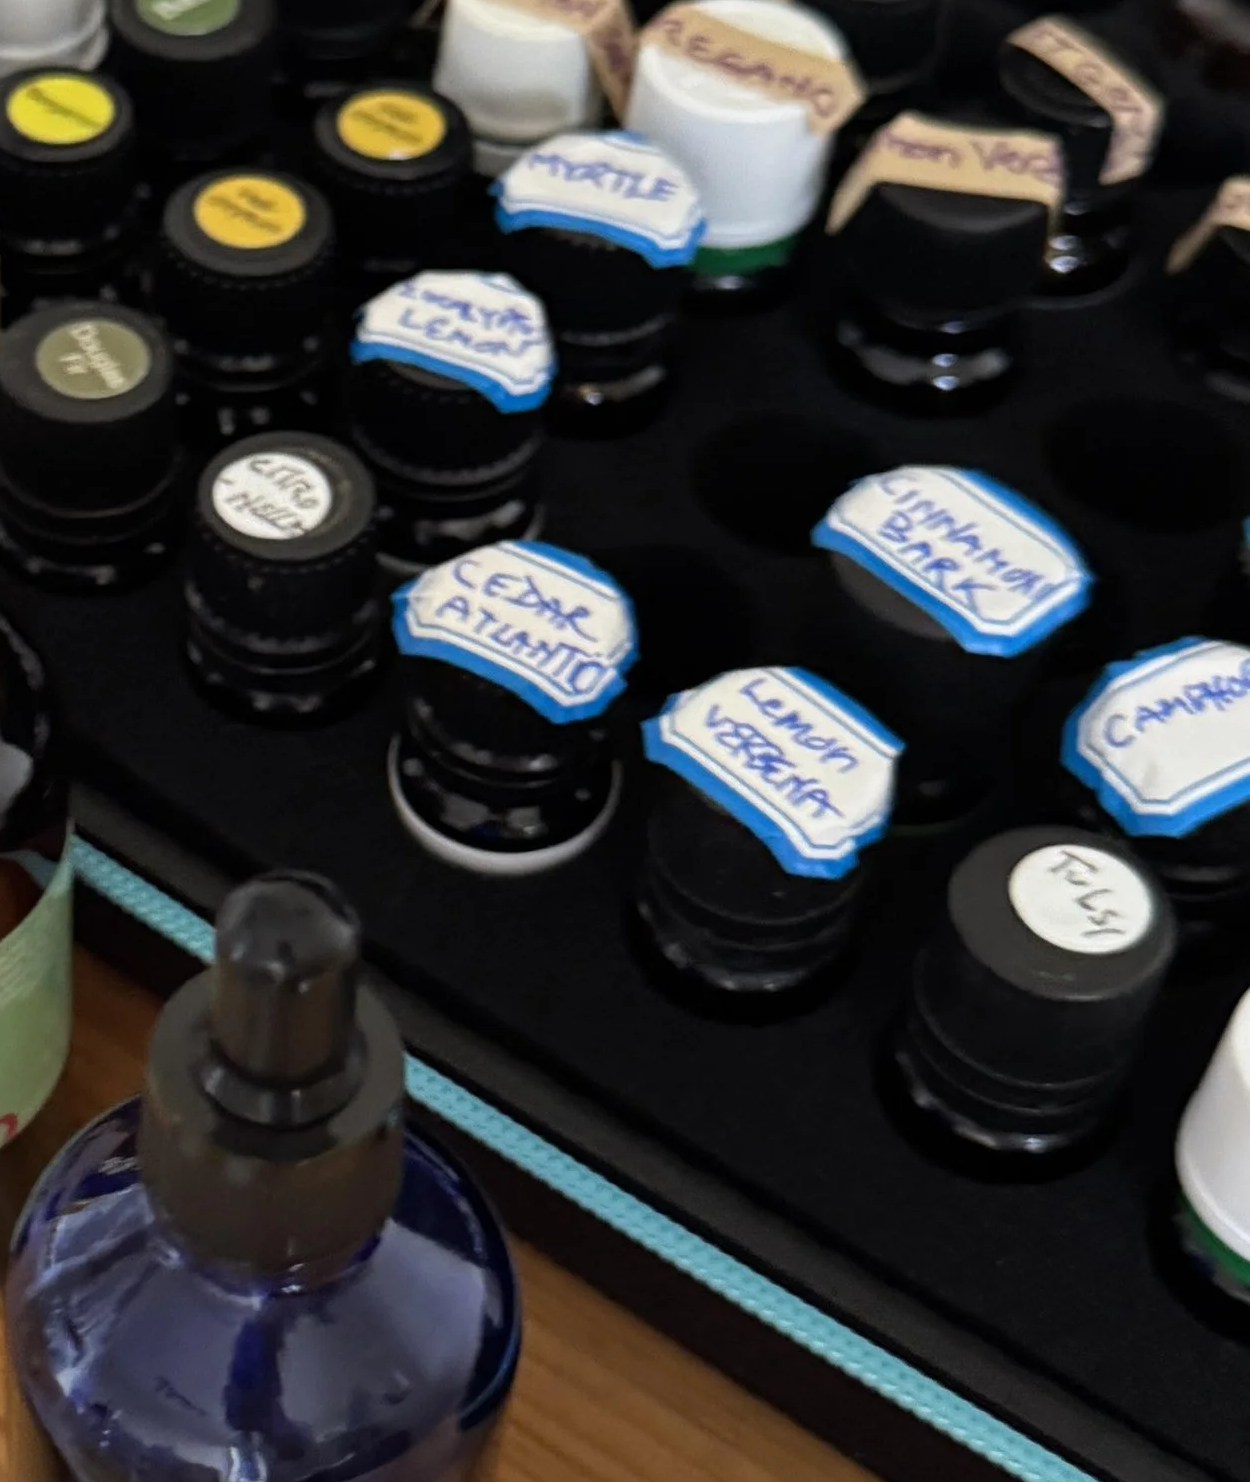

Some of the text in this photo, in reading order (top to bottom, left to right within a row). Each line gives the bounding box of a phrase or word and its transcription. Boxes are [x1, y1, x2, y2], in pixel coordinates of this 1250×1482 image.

[529, 152, 678, 202] MYRTLE
[877, 510, 997, 617] BARK
[879, 471, 1055, 601] CINNAMON
[451, 558, 598, 643] CEDAR
